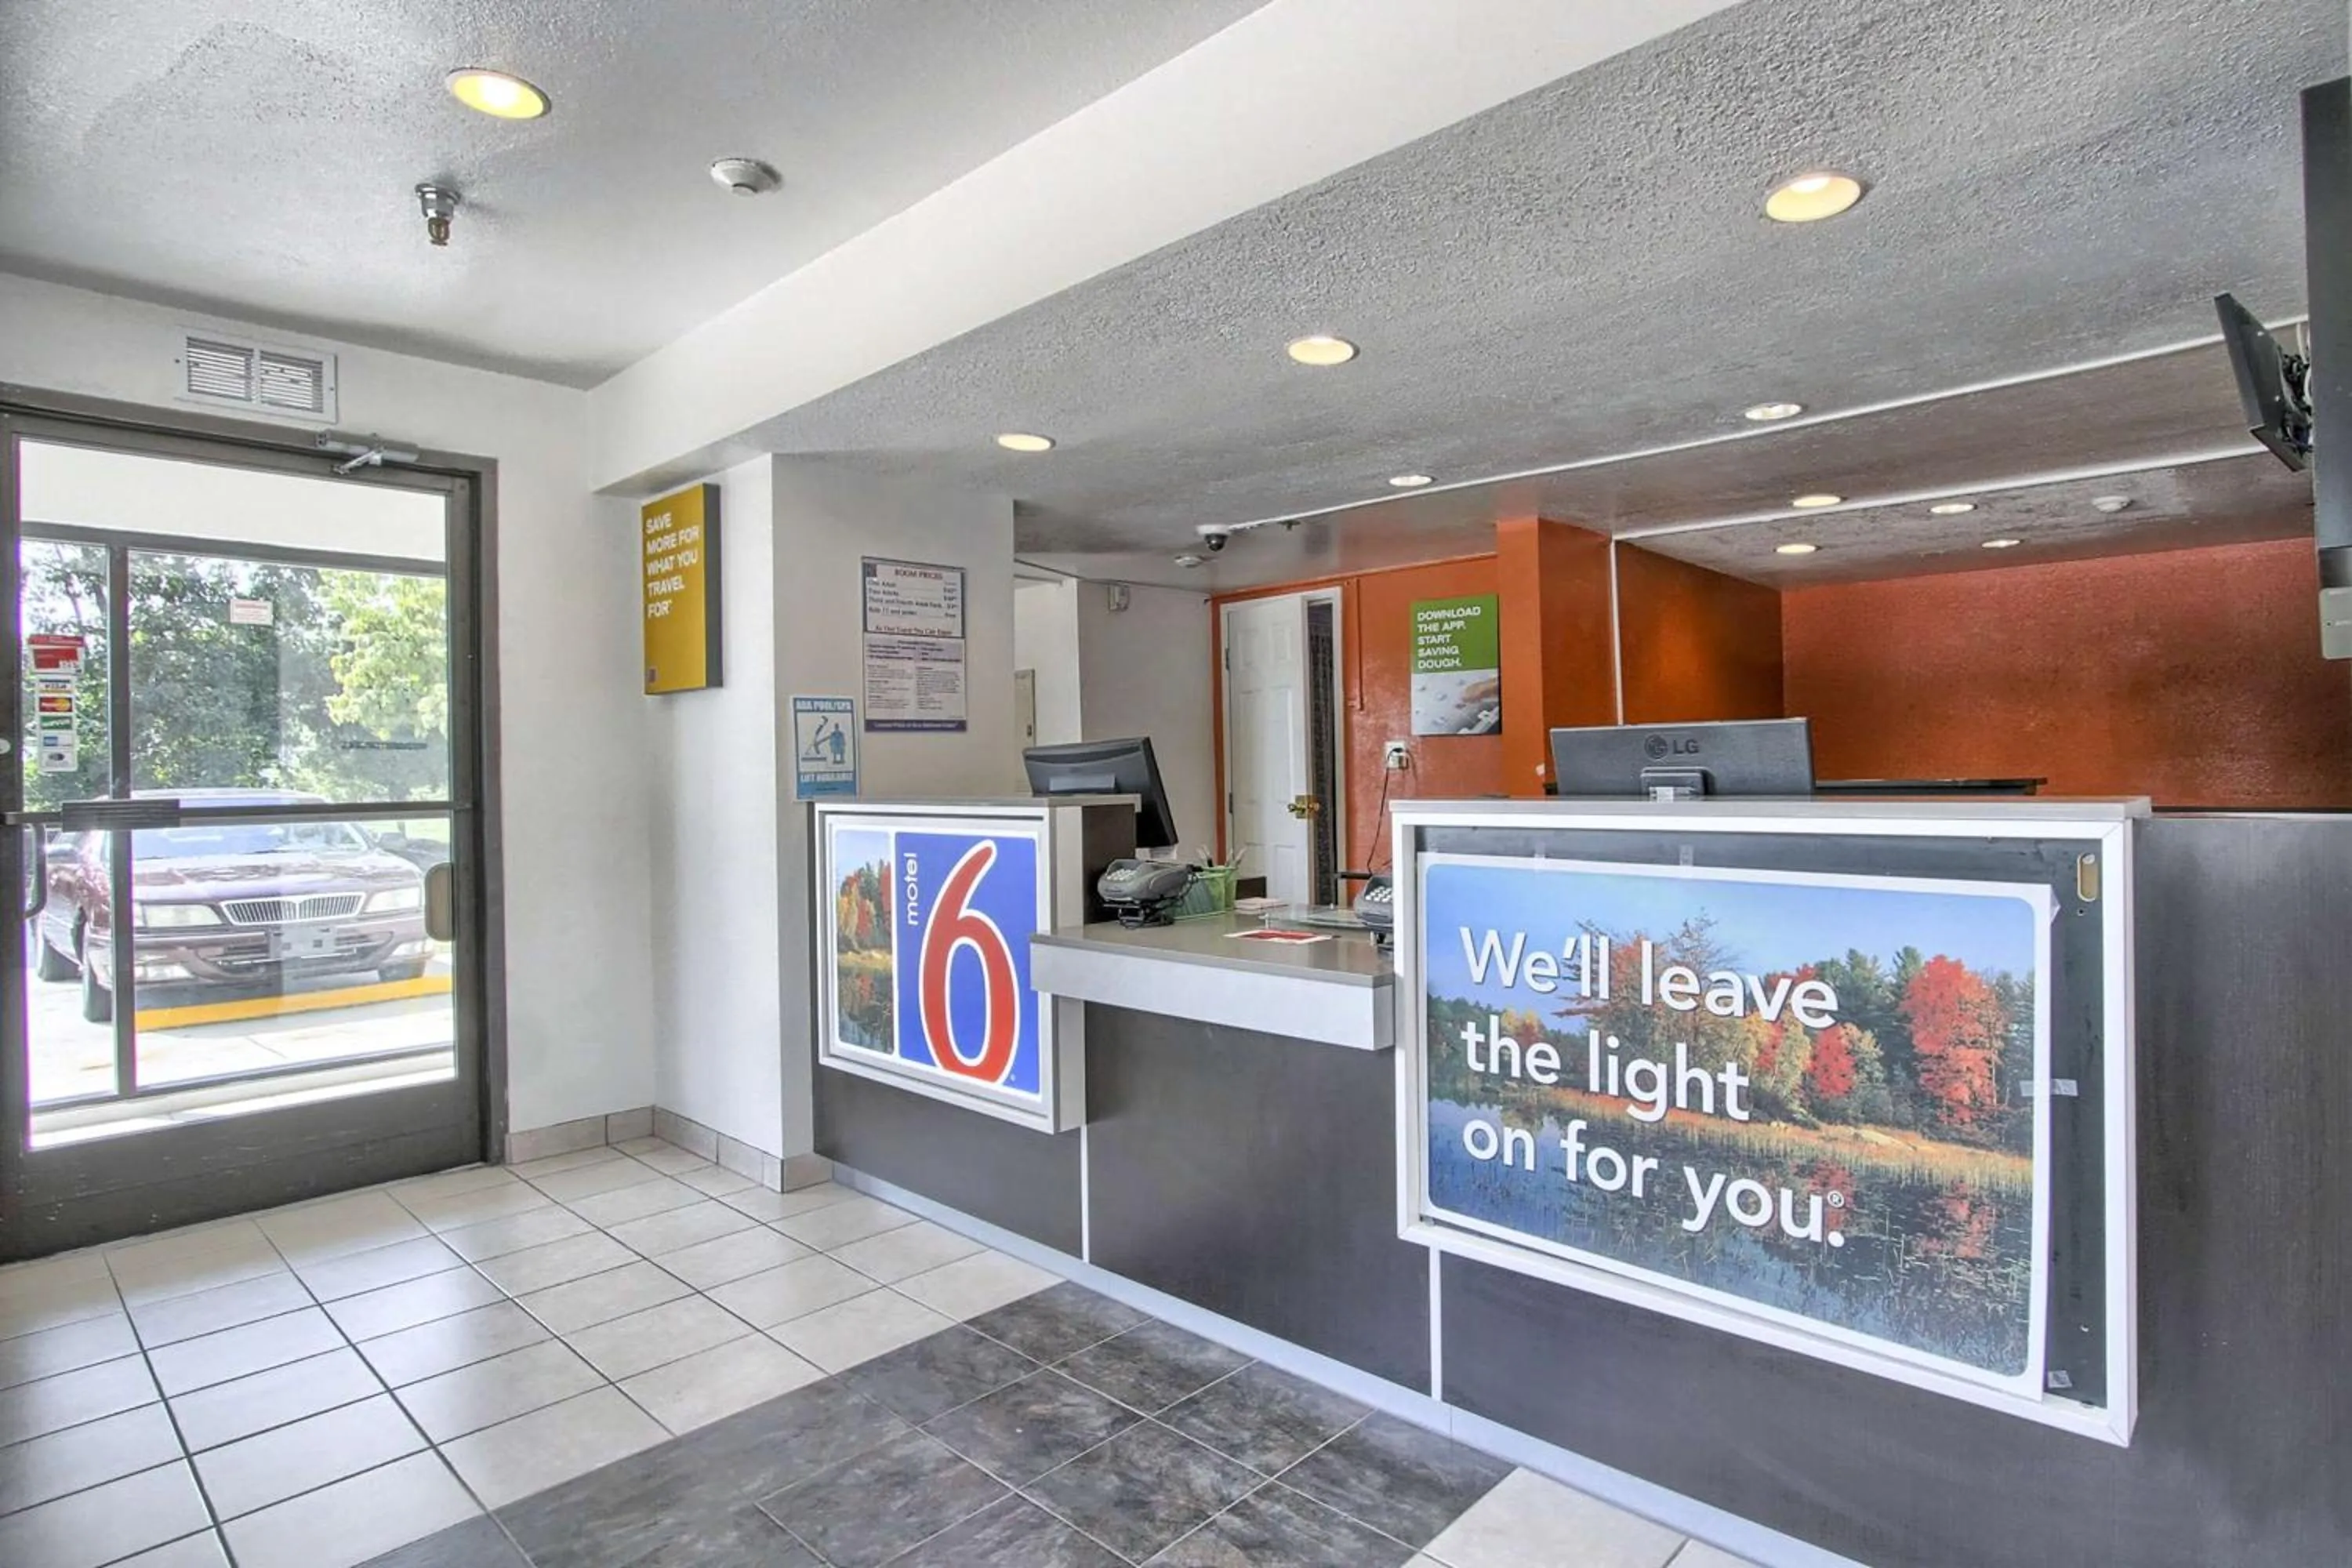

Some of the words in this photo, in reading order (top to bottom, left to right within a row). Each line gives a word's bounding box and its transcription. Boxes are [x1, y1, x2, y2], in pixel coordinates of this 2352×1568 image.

[646, 513, 672, 533] SAVE
[647, 533, 677, 554] MORE
[678, 526, 699, 548] FOR
[647, 555, 674, 576] WHAT
[677, 550, 699, 568] YOU
[648, 575, 685, 597] TRAVEL
[648, 601, 670, 619] FOR
[1417, 606, 1481, 621] DOWNLOAD
[1417, 623, 1439, 633] THE
[1417, 634, 1452, 644] START
[1417, 645, 1460, 657] SAVING
[1673, 739, 1700, 754] LG
[903, 852, 918, 925] motel
[918, 839, 1020, 1085] 6
[1457, 927, 1610, 1002] We'll
[1641, 940, 1838, 1029] leave
[1460, 1015, 1562, 1085] the
[1588, 1029, 1750, 1123] light
[1463, 1119, 1536, 1172] on
[1560, 1119, 1659, 1198] for
